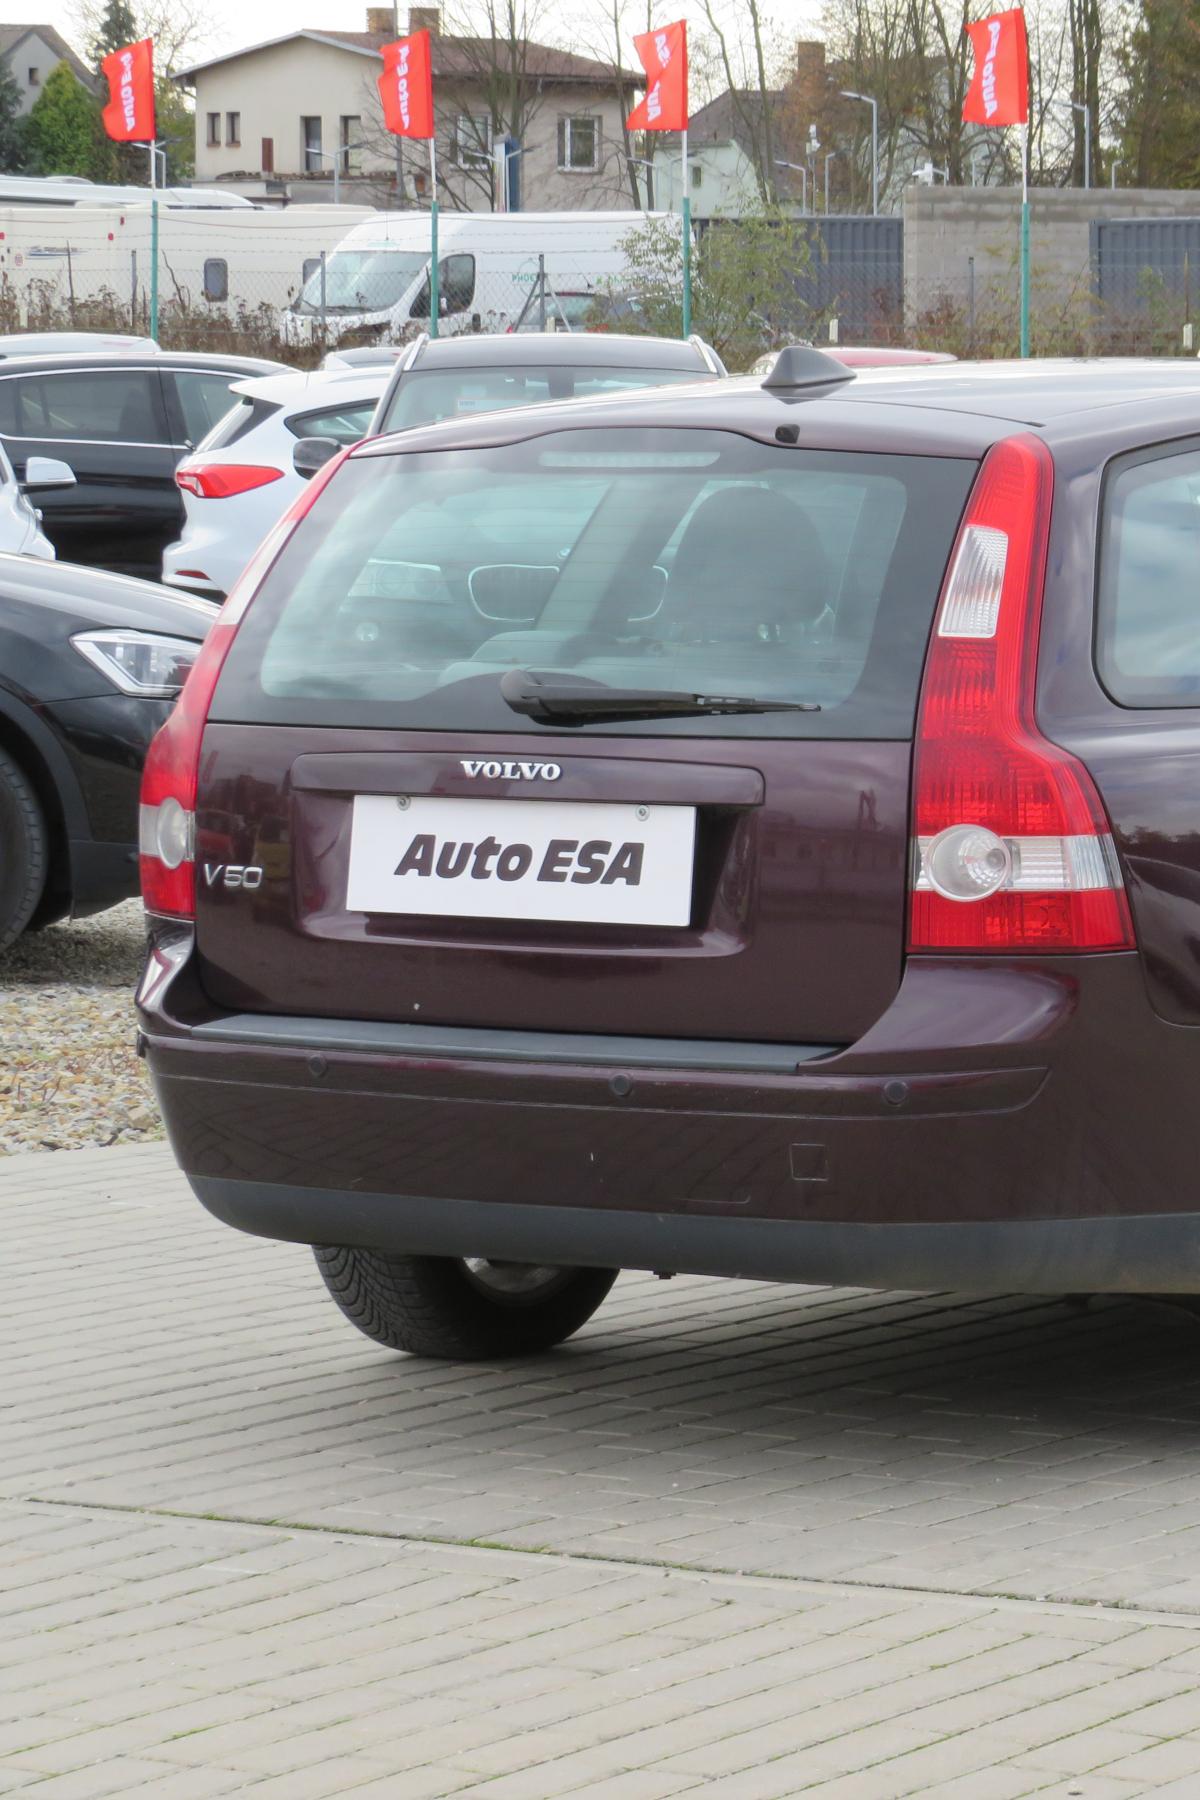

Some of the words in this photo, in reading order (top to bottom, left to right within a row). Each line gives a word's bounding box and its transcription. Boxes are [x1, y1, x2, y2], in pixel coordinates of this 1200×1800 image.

[460, 760, 561, 782] VOLVO
[394, 833, 533, 882] Auto
[536, 839, 645, 886] ESA
[203, 863, 263, 889] V50
